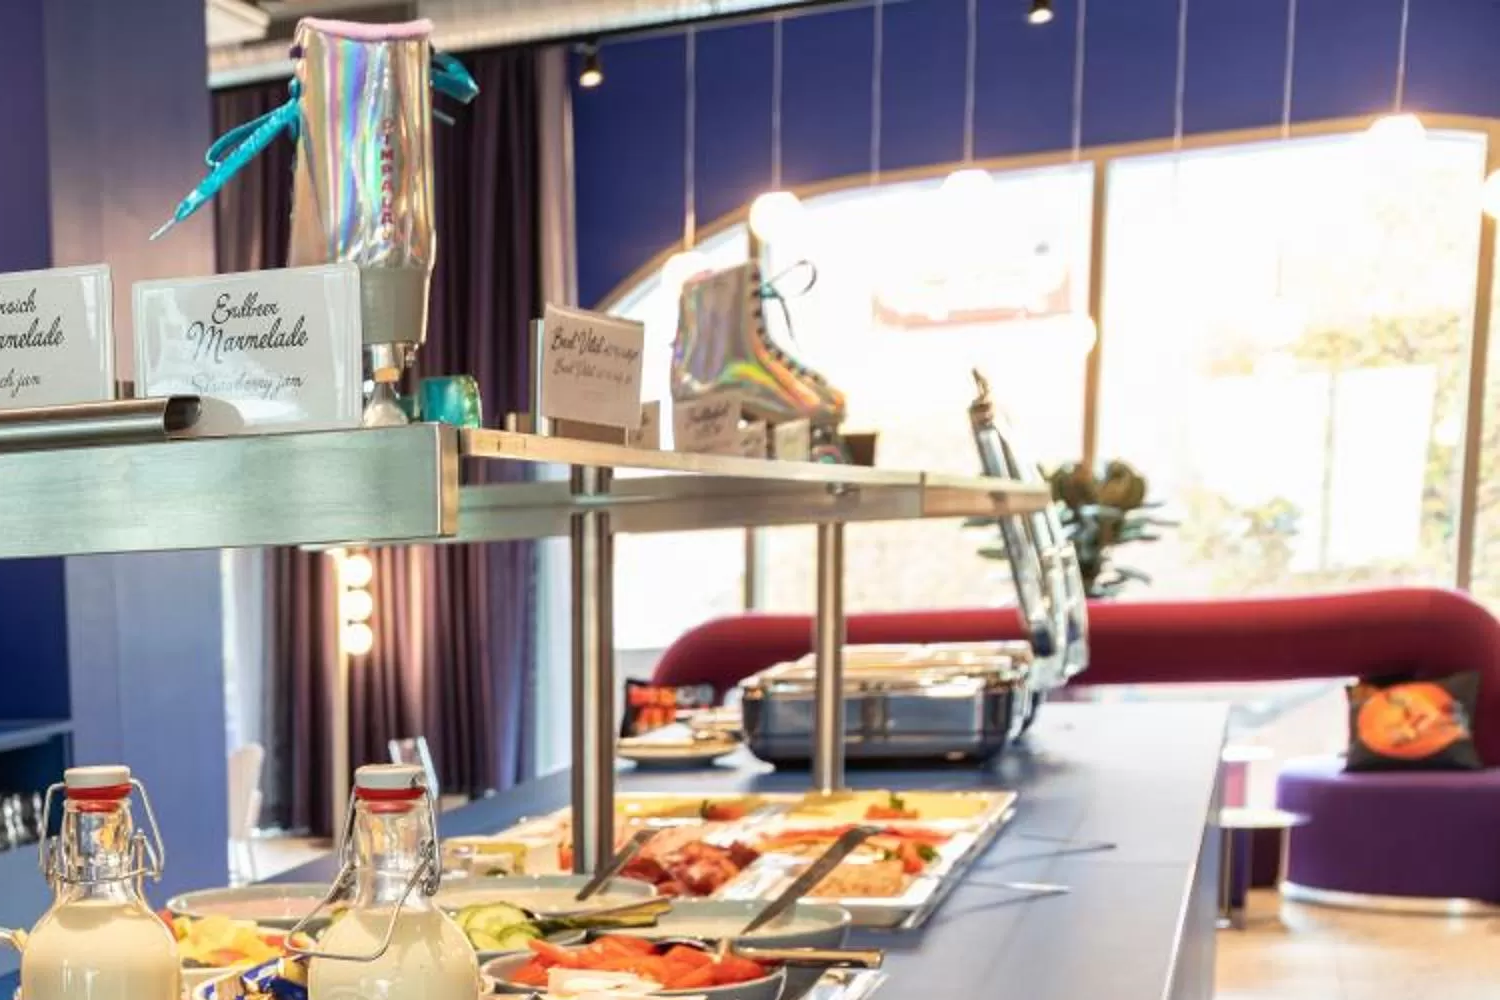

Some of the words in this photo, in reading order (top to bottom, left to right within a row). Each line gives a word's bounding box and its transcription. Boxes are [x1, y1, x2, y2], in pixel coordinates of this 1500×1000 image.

[211, 291, 280, 325] Erdbeer
[187, 314, 309, 364] Marmelade
[10, 375, 41, 398] jam
